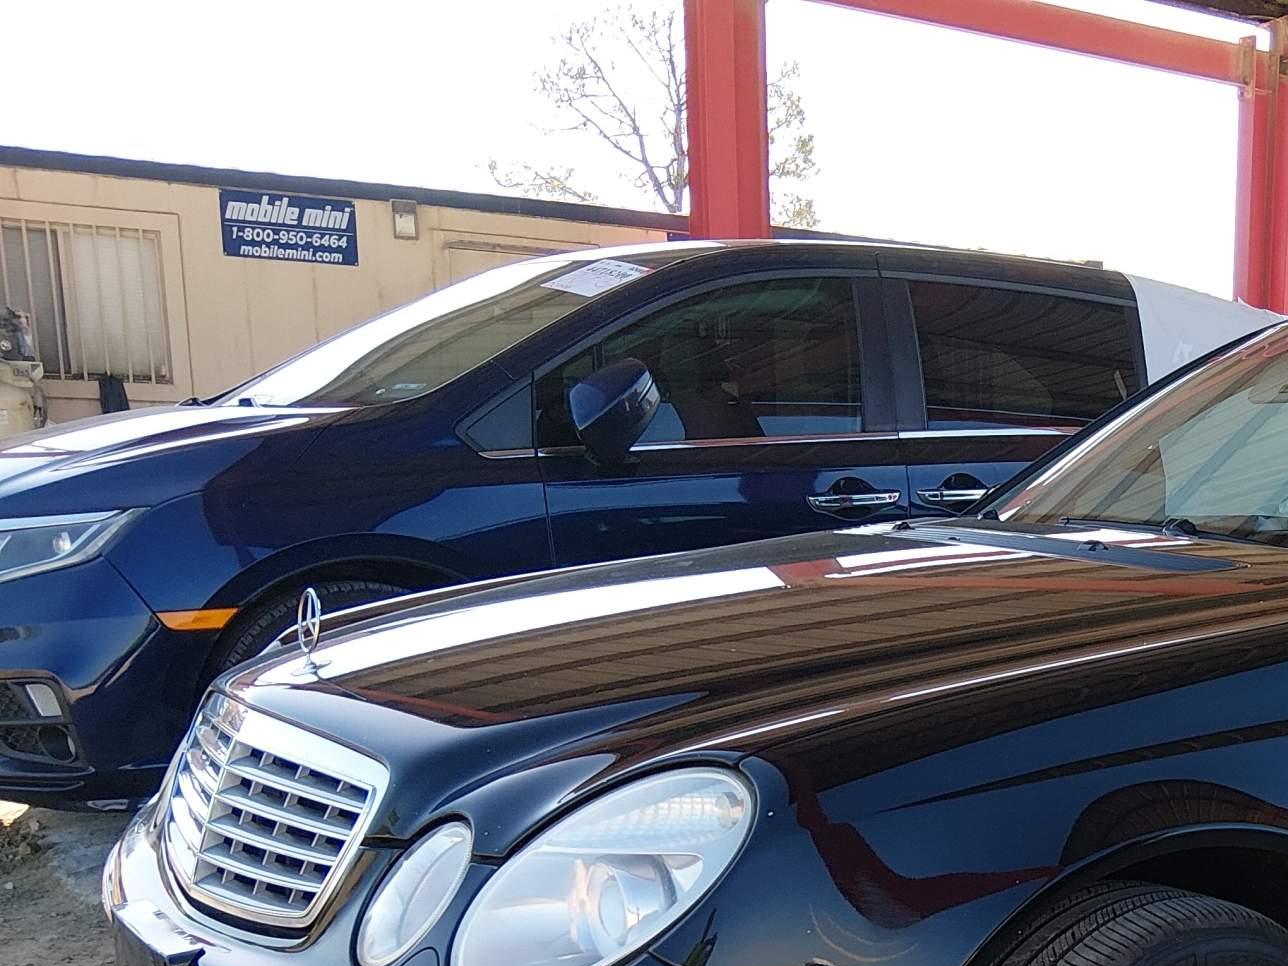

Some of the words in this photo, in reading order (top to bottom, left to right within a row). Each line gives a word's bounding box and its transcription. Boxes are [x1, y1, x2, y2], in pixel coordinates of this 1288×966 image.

[225, 195, 300, 225] mobile
[302, 205, 350, 229] mini
[231, 226, 348, 248] 1-800-950-6464
[240, 244, 343, 263] mobilemini.com
